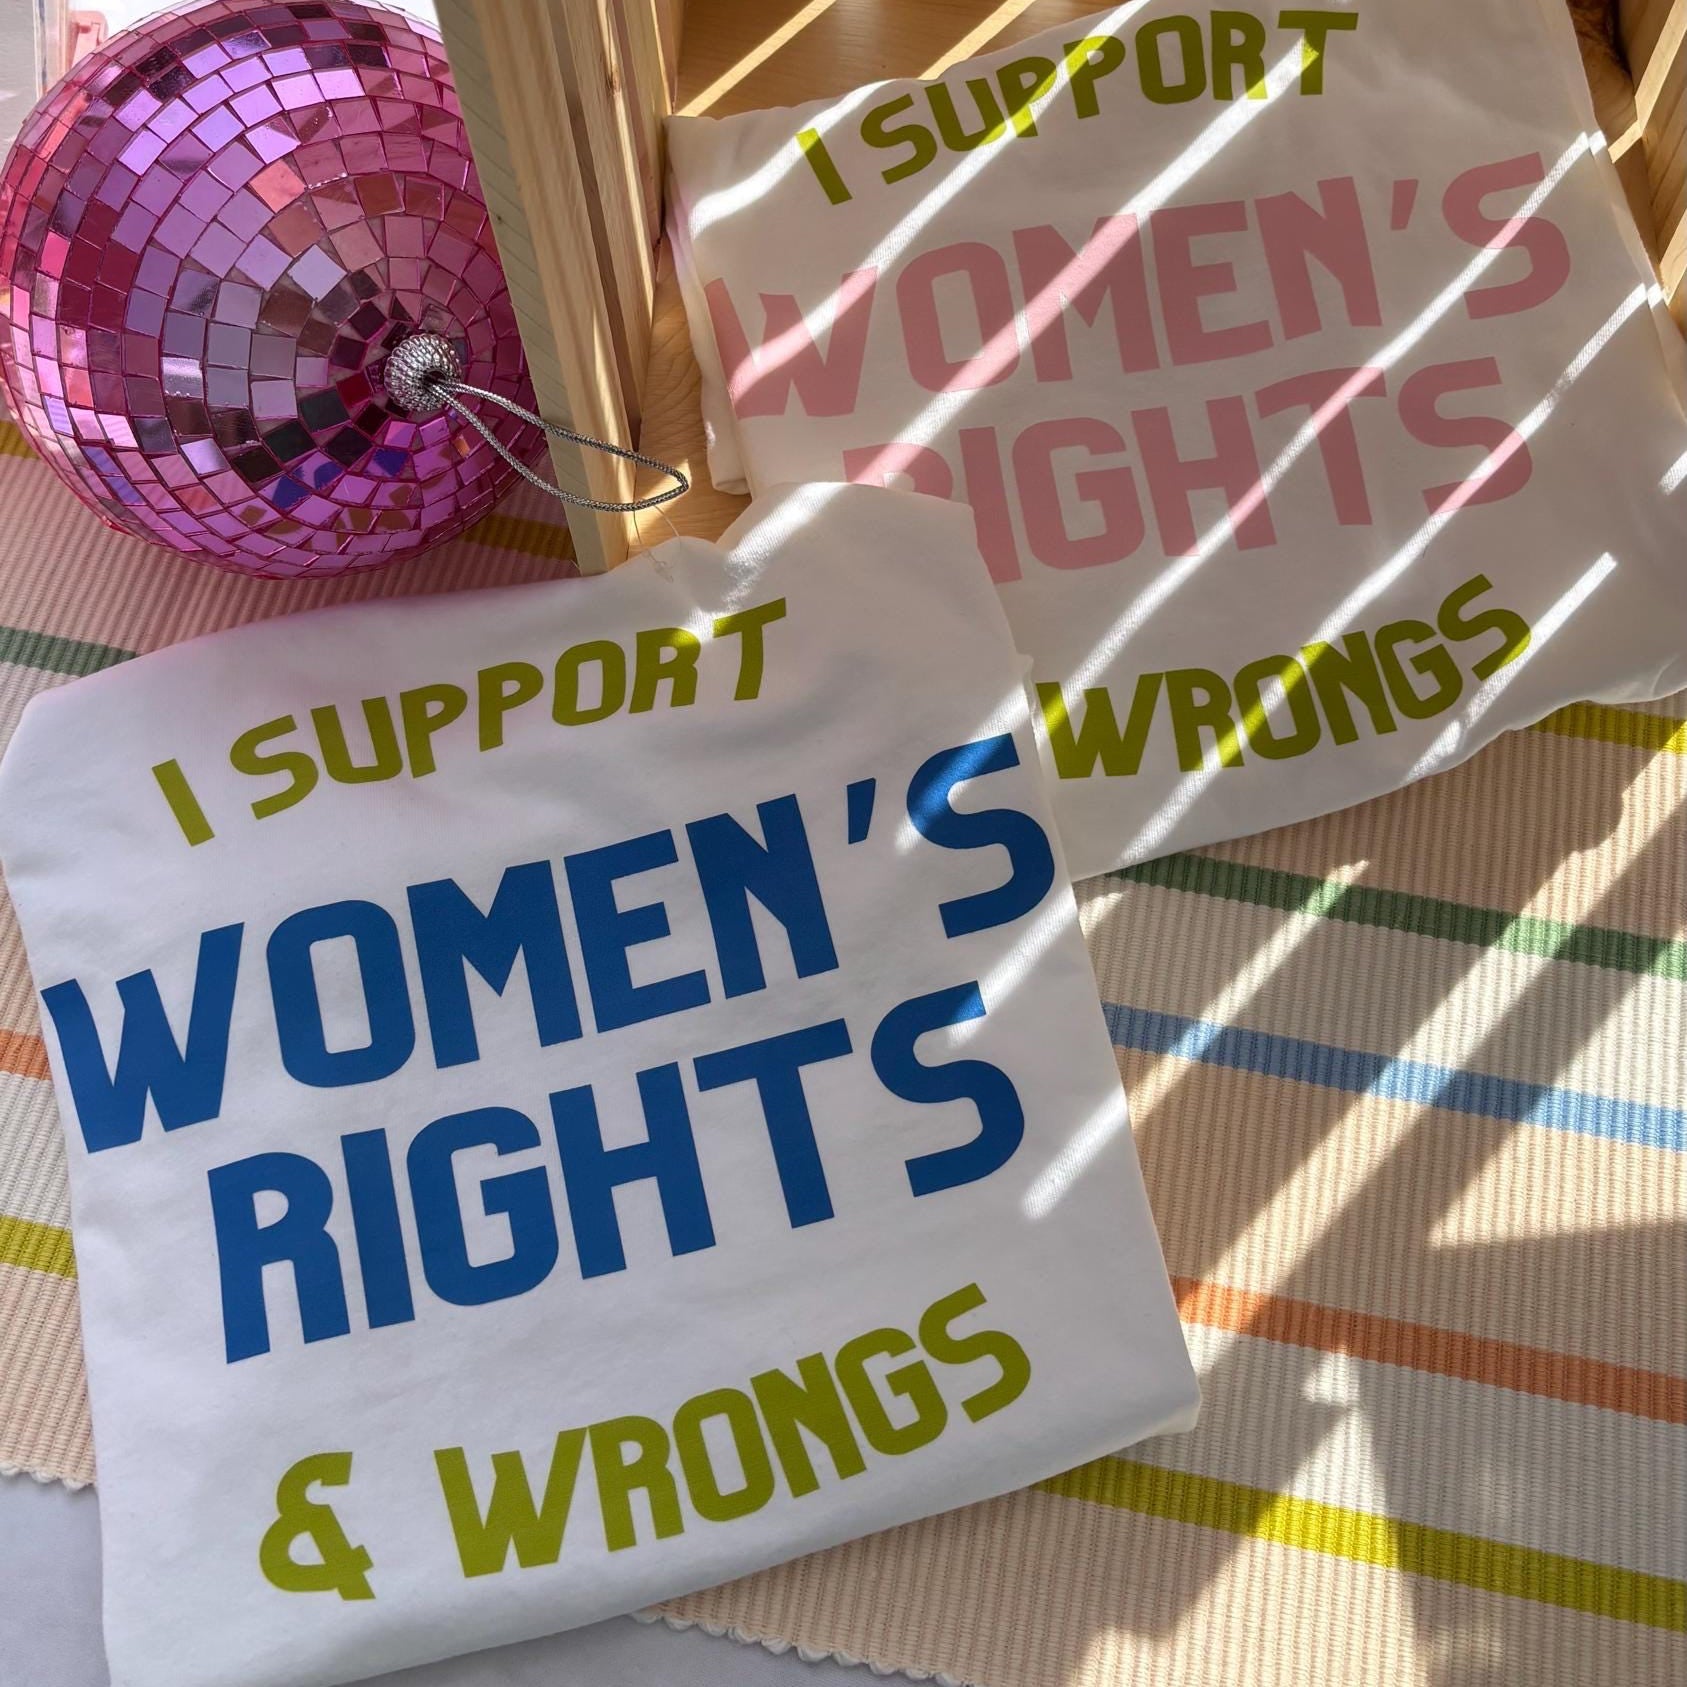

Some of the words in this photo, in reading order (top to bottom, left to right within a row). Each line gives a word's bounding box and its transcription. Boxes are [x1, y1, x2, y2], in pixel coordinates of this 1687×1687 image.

[798, 129, 853, 205] I
[860, 11, 1358, 184] SUPPORT
[704, 152, 1571, 418] WOMEN'S
[152, 759, 215, 846] I
[230, 598, 788, 820] SUPPORT
[1036, 573, 1531, 779] WRONGS
[41, 734, 1056, 1153] WOMEN'S
[207, 980, 1026, 1364] RIGHTS
[259, 1451, 376, 1601] &
[435, 1282, 1032, 1579] WRONGS
